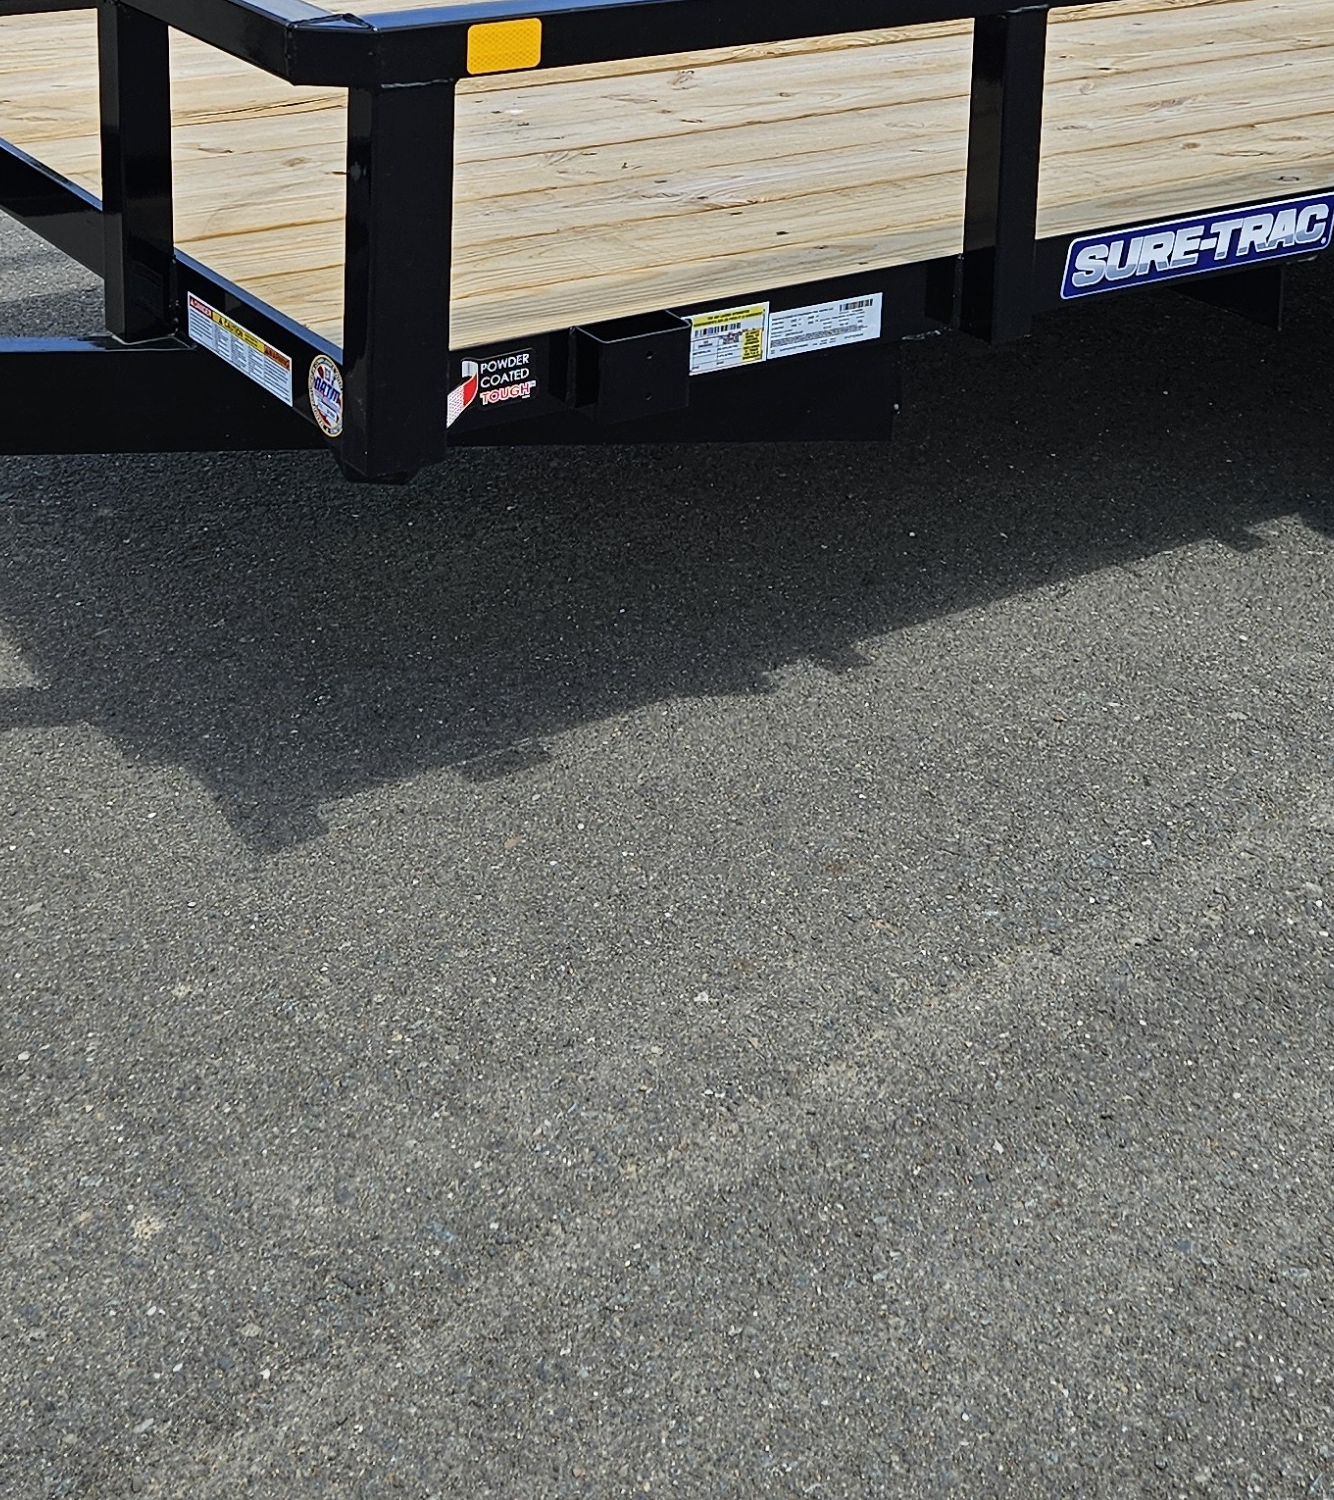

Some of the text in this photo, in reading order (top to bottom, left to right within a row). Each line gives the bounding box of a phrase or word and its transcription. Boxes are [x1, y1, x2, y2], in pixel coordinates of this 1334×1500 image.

[1072, 203, 1330, 288] SURE-TRAC
[480, 353, 530, 374] POWDER
[480, 368, 530, 388] COATED
[479, 382, 531, 406] TOUGH
